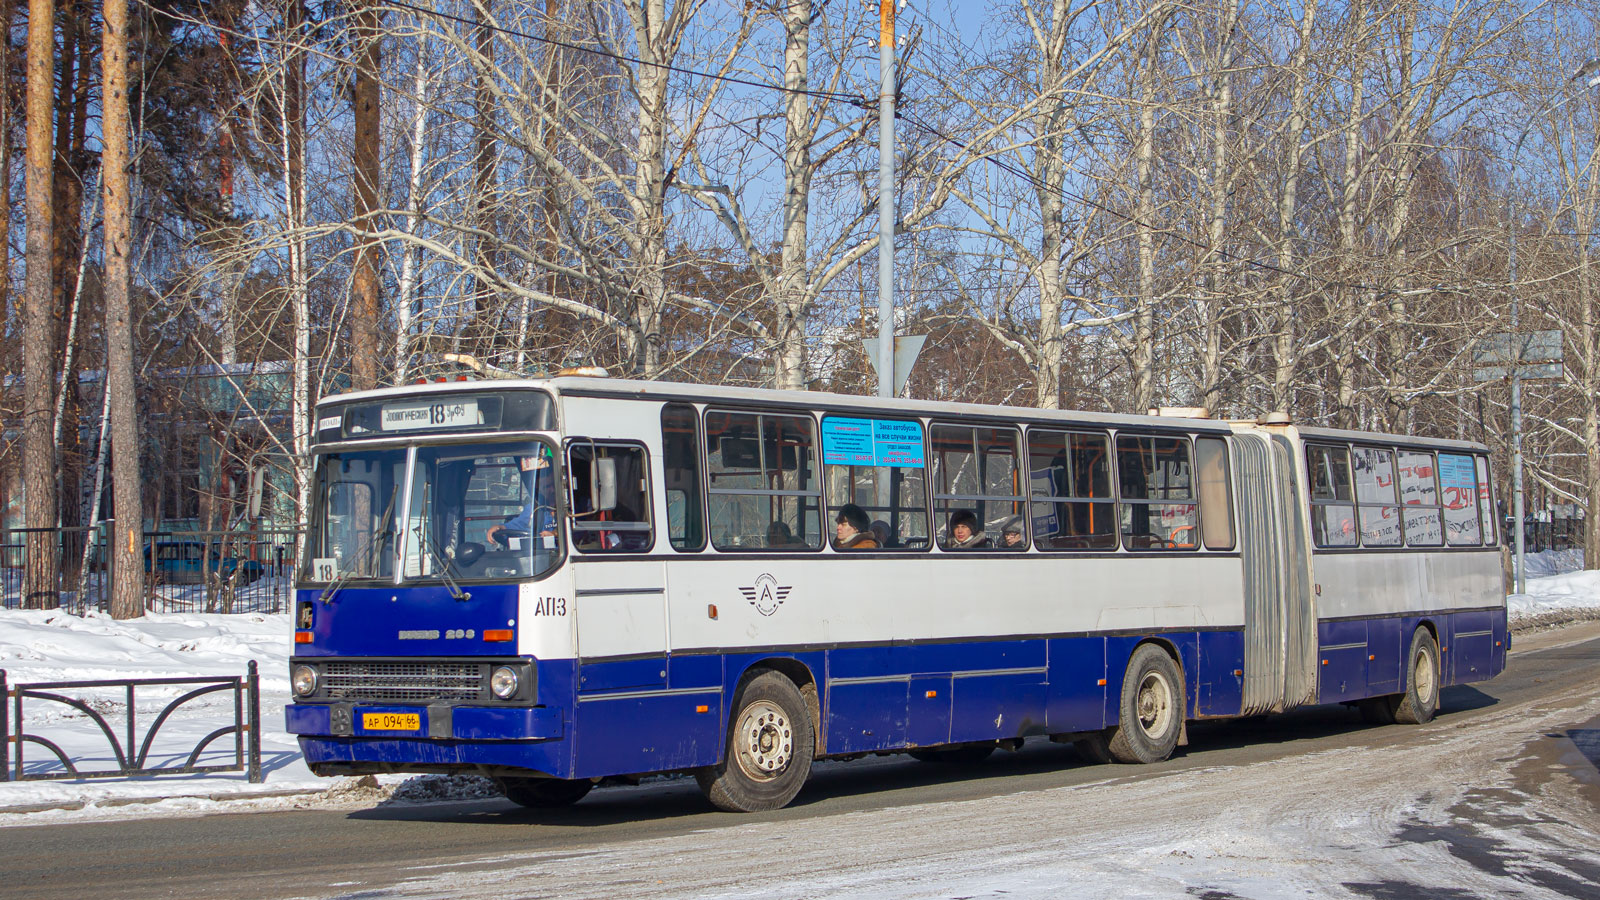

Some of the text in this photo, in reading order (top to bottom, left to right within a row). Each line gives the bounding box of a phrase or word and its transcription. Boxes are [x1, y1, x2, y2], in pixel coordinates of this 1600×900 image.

[429, 404, 446, 424] 18
[879, 422, 892, 430] Заказ
[893, 424, 916, 432] автобусов
[319, 564, 333, 581] 18
[383, 716, 402, 728] 094
[406, 715, 416, 724] 66
